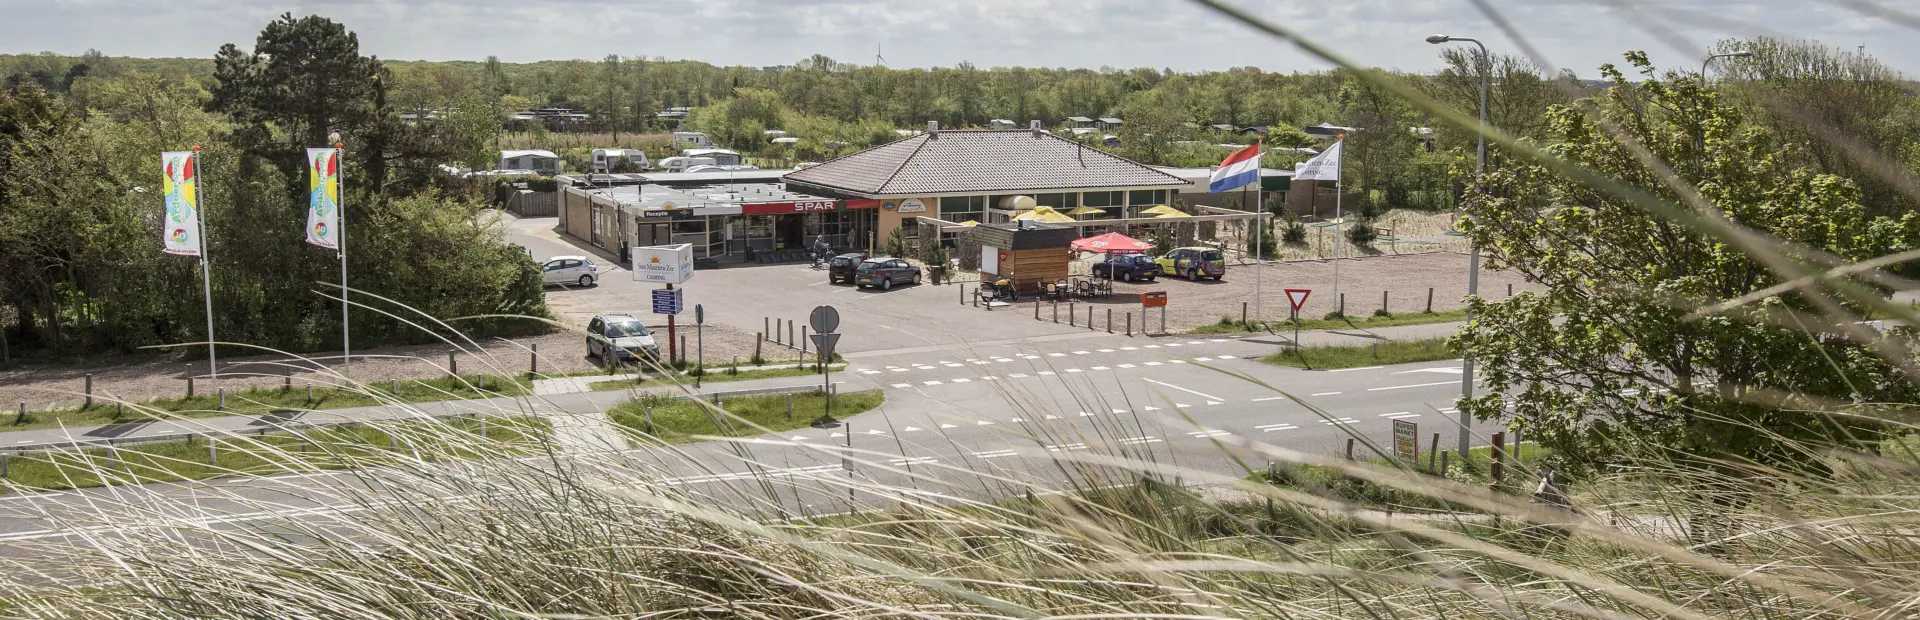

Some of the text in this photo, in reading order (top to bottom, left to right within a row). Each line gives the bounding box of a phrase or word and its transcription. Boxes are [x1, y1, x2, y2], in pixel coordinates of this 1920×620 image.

[794, 201, 834, 211] SPAR
[1396, 422, 1413, 430] SUPER
[1396, 428, 1413, 437] MARKT
